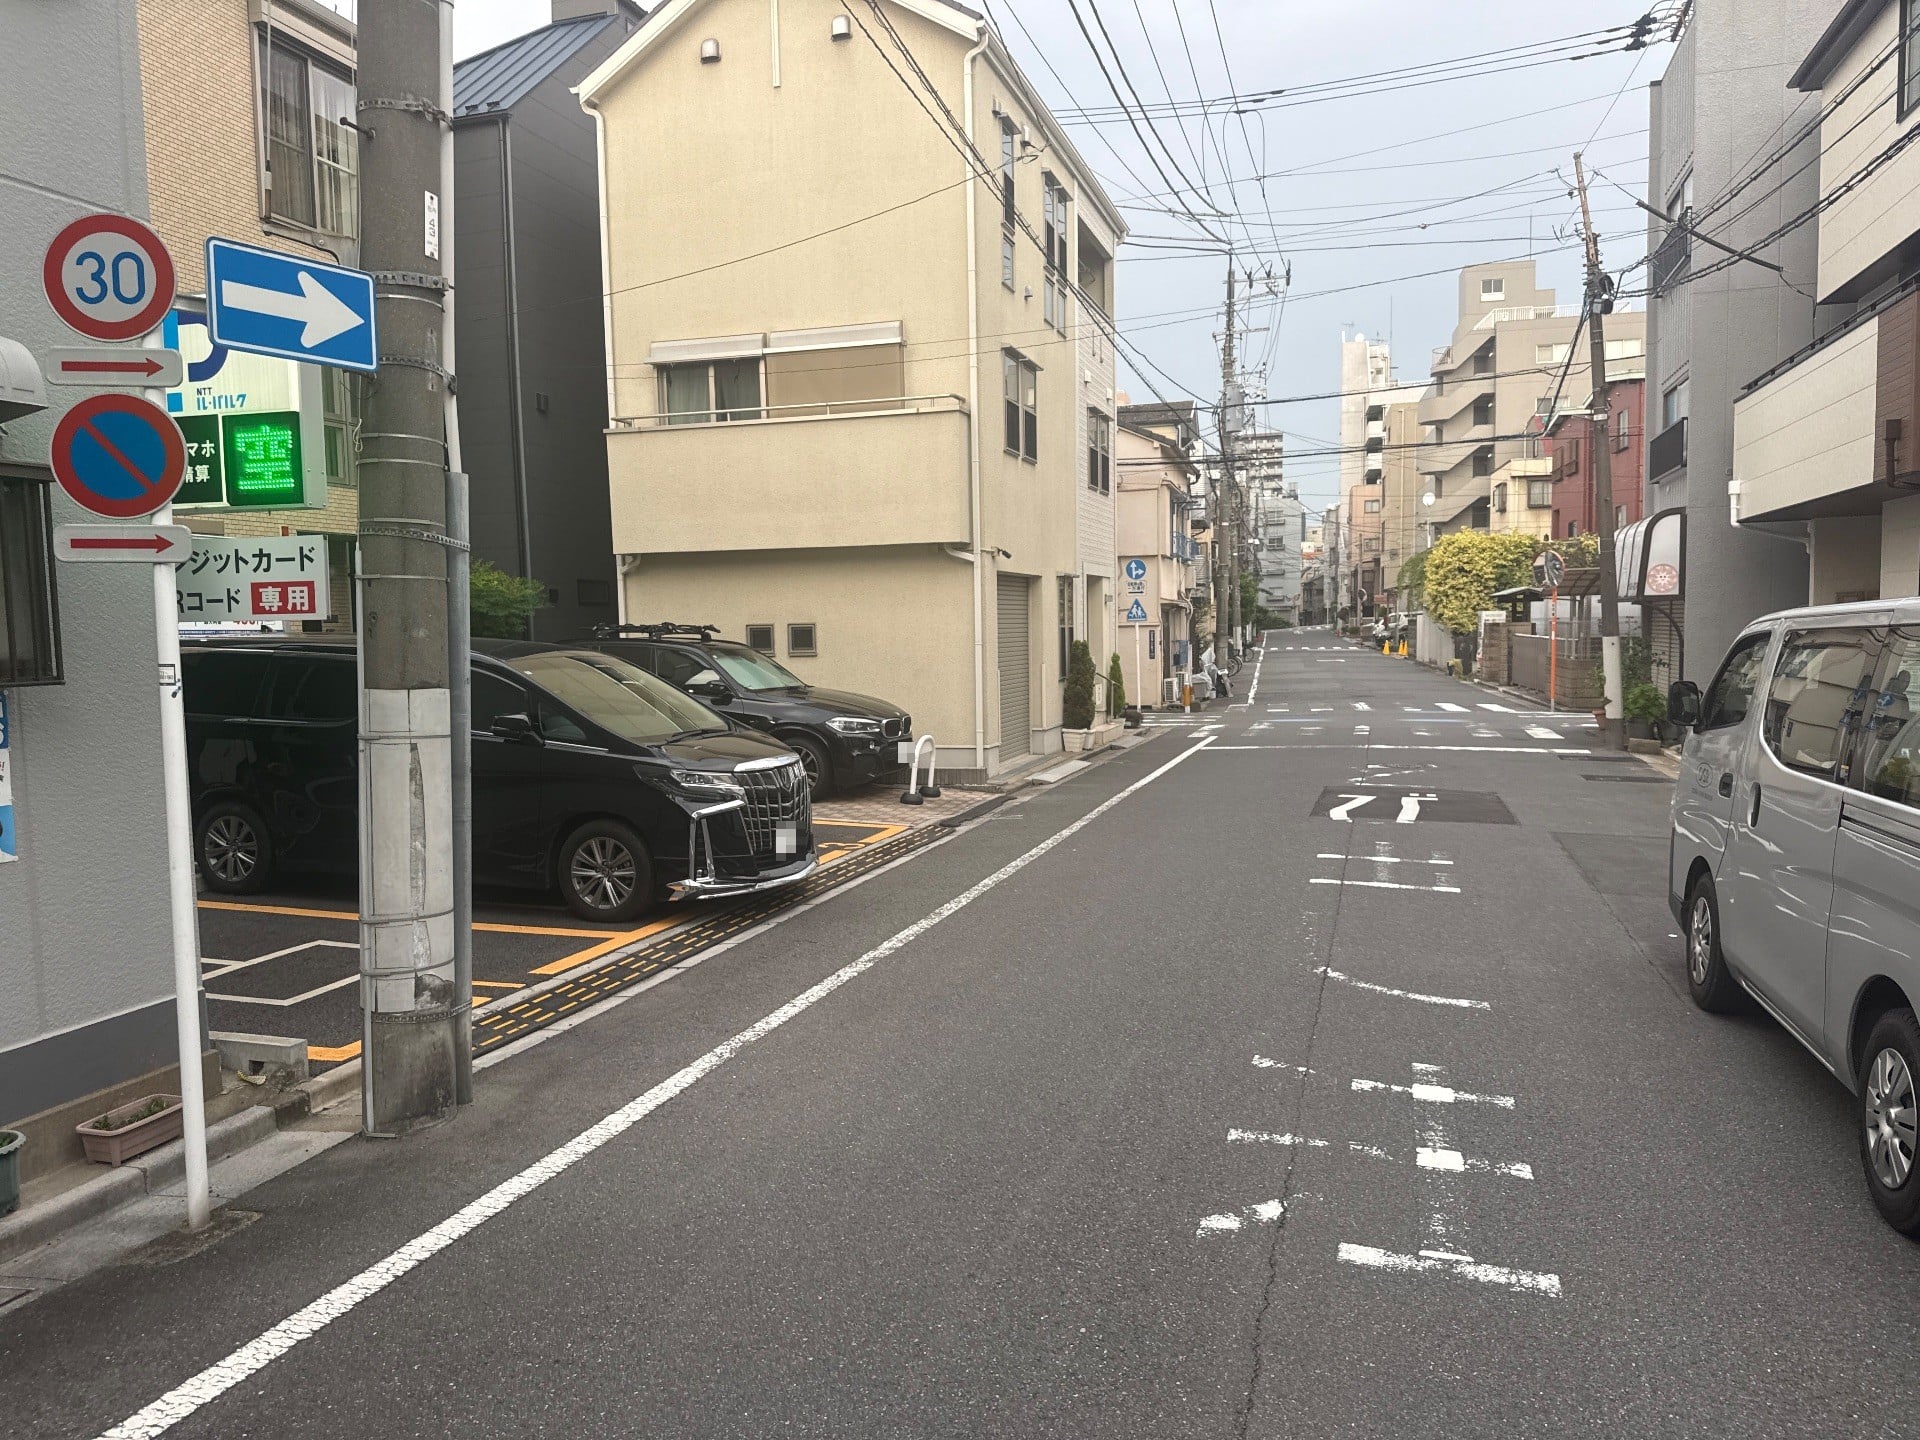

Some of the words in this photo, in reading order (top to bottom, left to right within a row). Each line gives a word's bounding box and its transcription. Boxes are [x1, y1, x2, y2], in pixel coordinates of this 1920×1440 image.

[76, 251, 146, 305] 30
[196, 387, 212, 396] NTT
[176, 545, 315, 575] ジットカード
[258, 585, 309, 612] 専用
